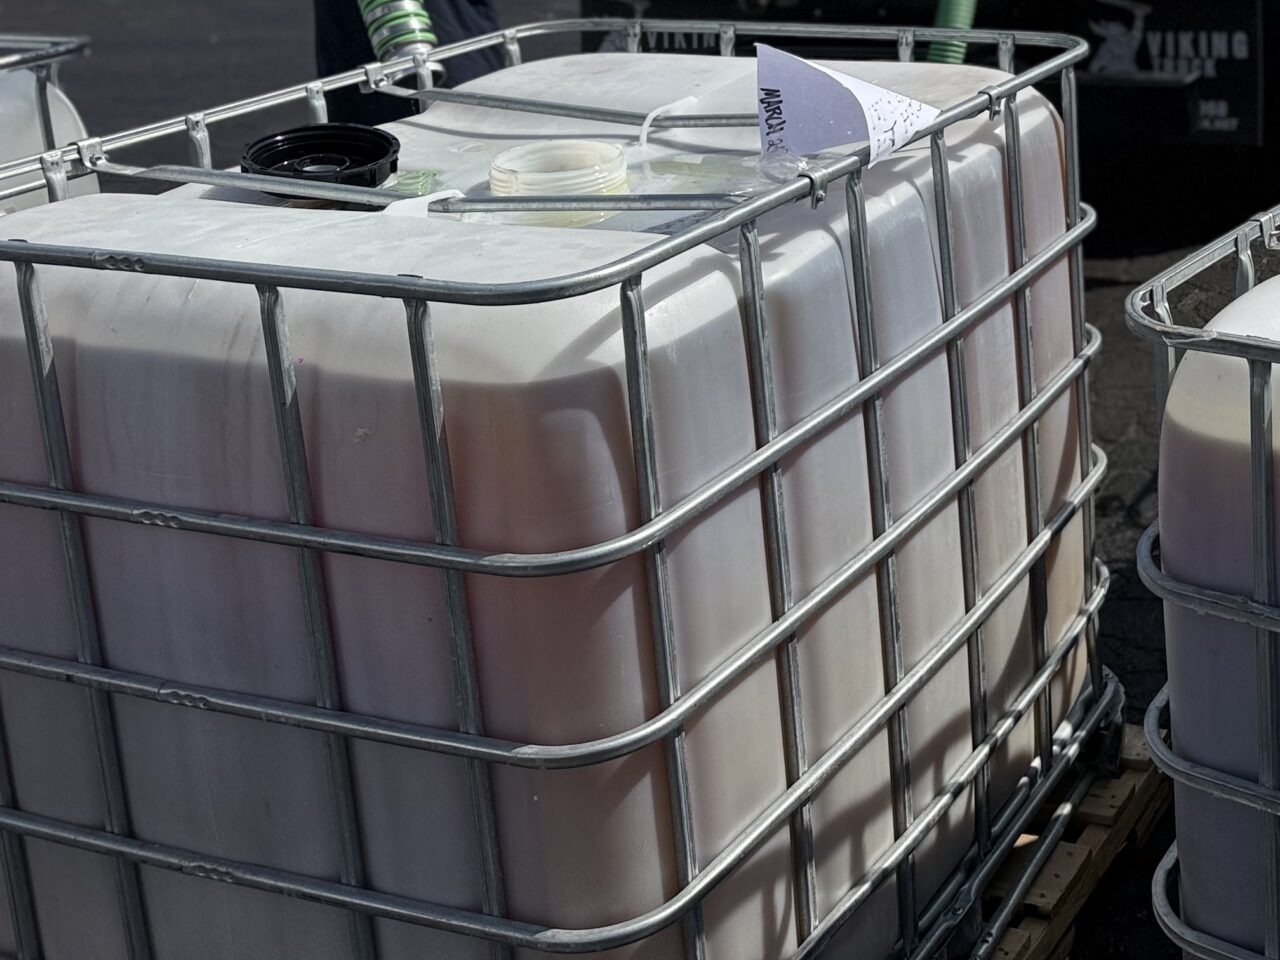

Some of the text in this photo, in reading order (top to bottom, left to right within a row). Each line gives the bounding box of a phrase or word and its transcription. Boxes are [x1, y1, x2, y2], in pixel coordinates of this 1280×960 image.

[646, 30, 717, 50] VIKIN
[1146, 30, 1249, 60] VIKING
[759, 87, 787, 136] MARCH
